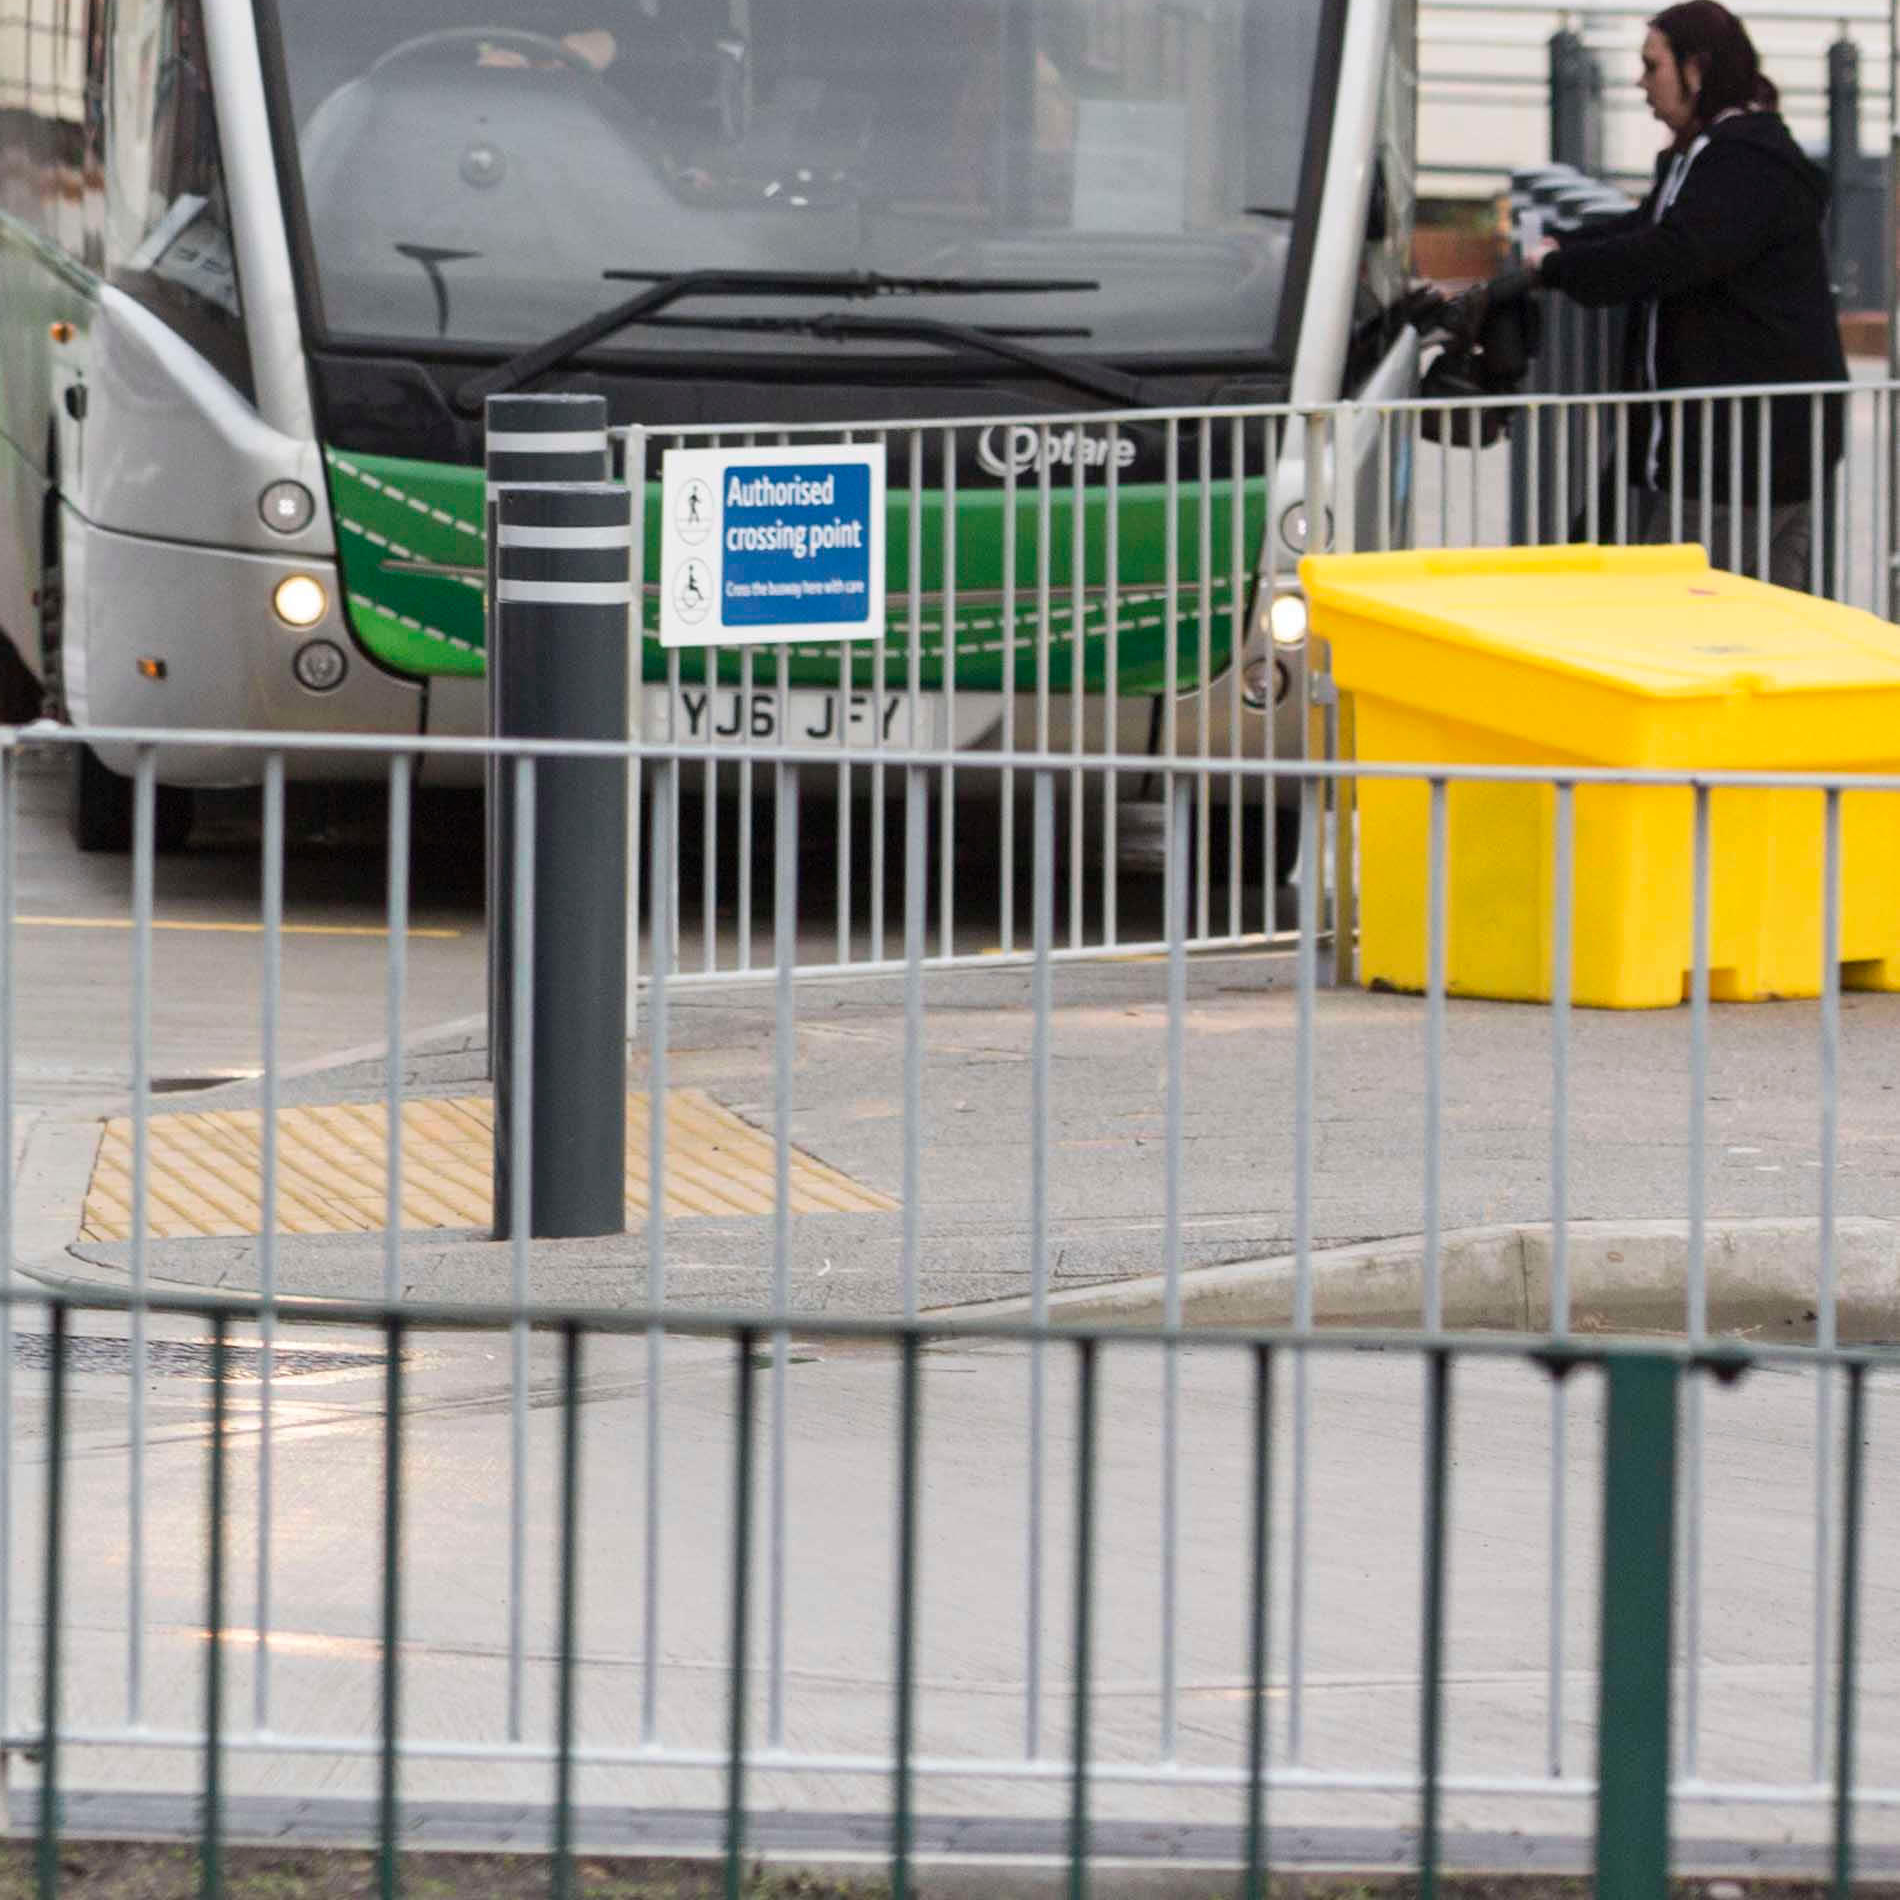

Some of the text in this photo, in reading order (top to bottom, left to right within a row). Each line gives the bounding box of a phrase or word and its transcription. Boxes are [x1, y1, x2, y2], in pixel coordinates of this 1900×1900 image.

[977, 425, 1136, 476] Optare
[726, 473, 835, 508] Authorised
[726, 518, 863, 560] crossing point
[682, 692, 776, 738] YJ6
